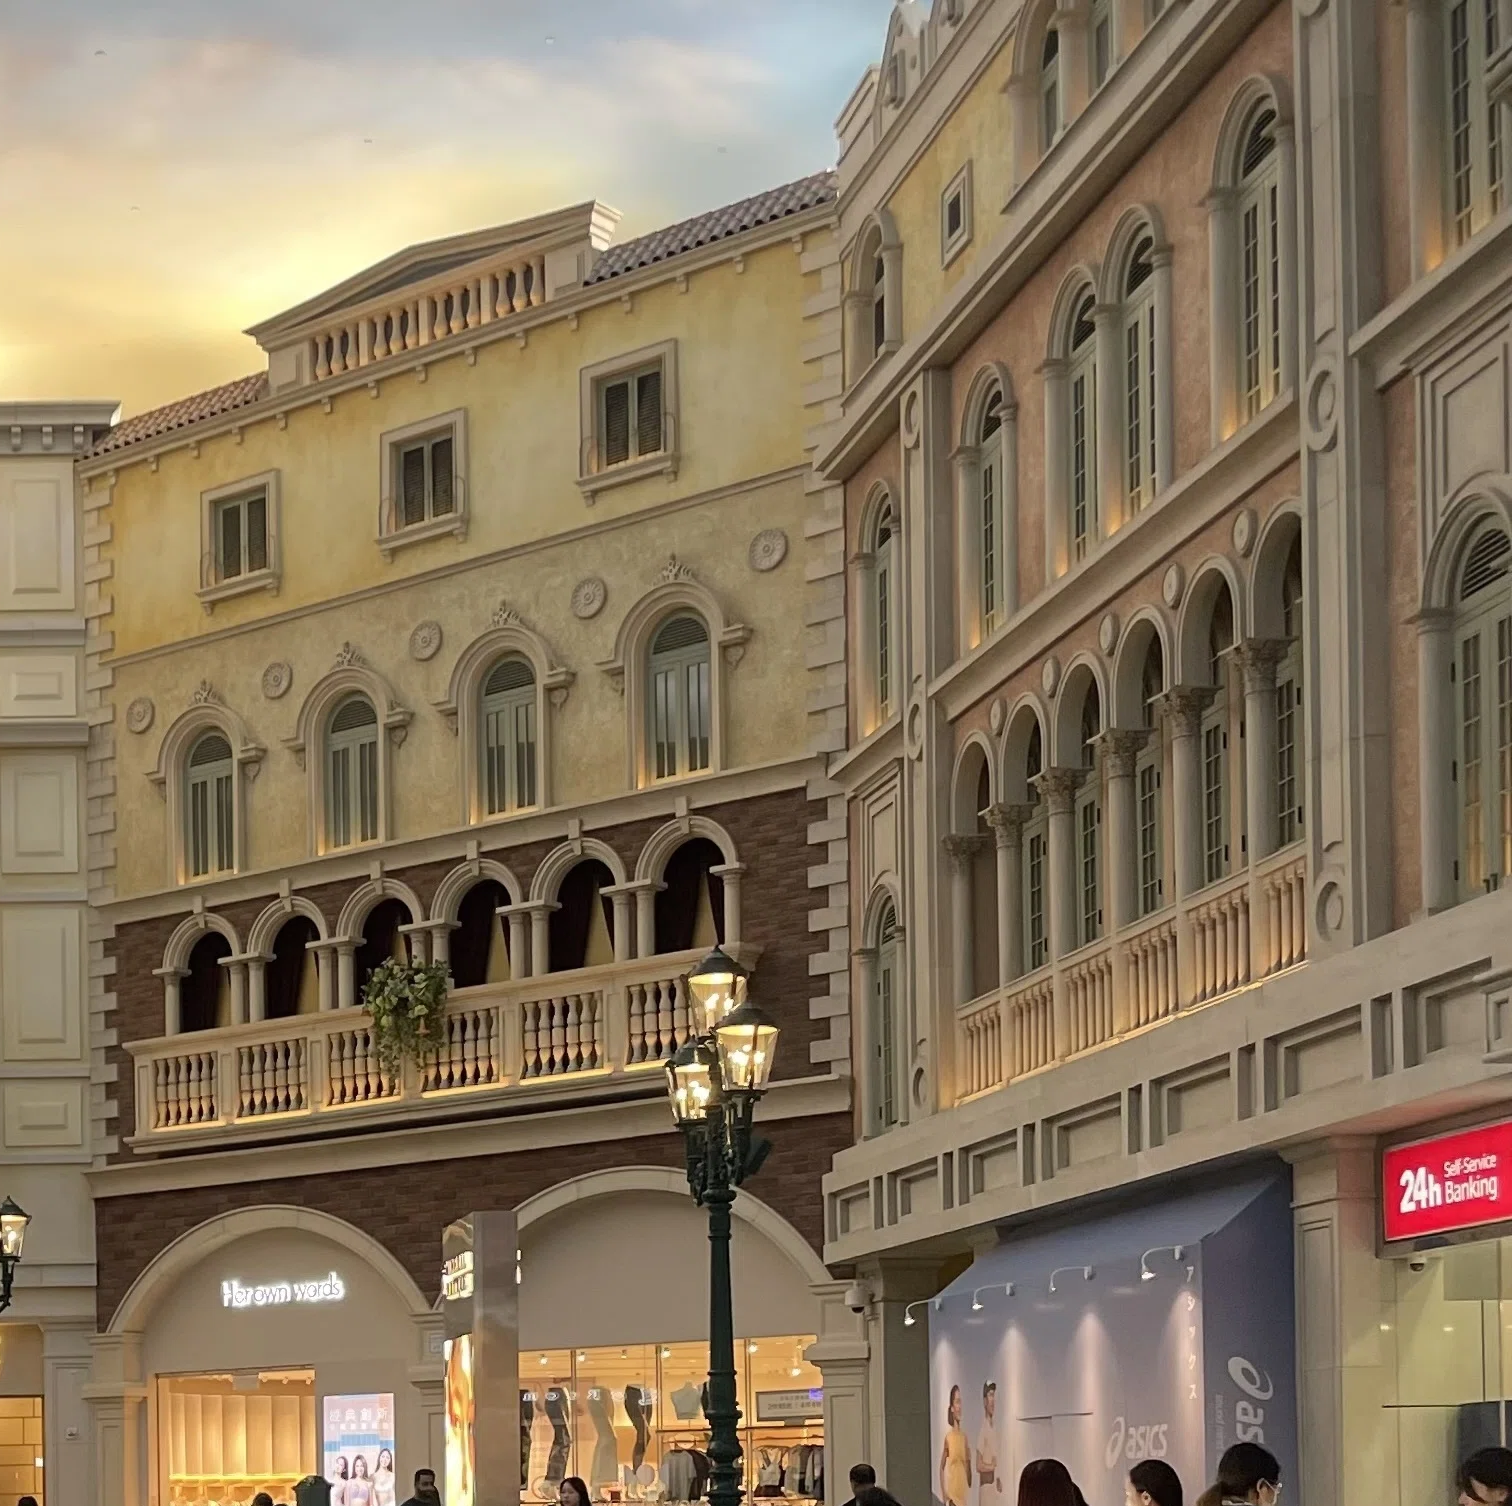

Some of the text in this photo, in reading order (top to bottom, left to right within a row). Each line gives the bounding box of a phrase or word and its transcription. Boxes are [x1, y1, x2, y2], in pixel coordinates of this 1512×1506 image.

[1443, 1153, 1497, 1178] Self-Service
[1399, 1166, 1442, 1214] 24h
[1444, 1175, 1498, 1204] Banking
[221, 1271, 345, 1307] Her own words
[1125, 1423, 1168, 1460] asics
